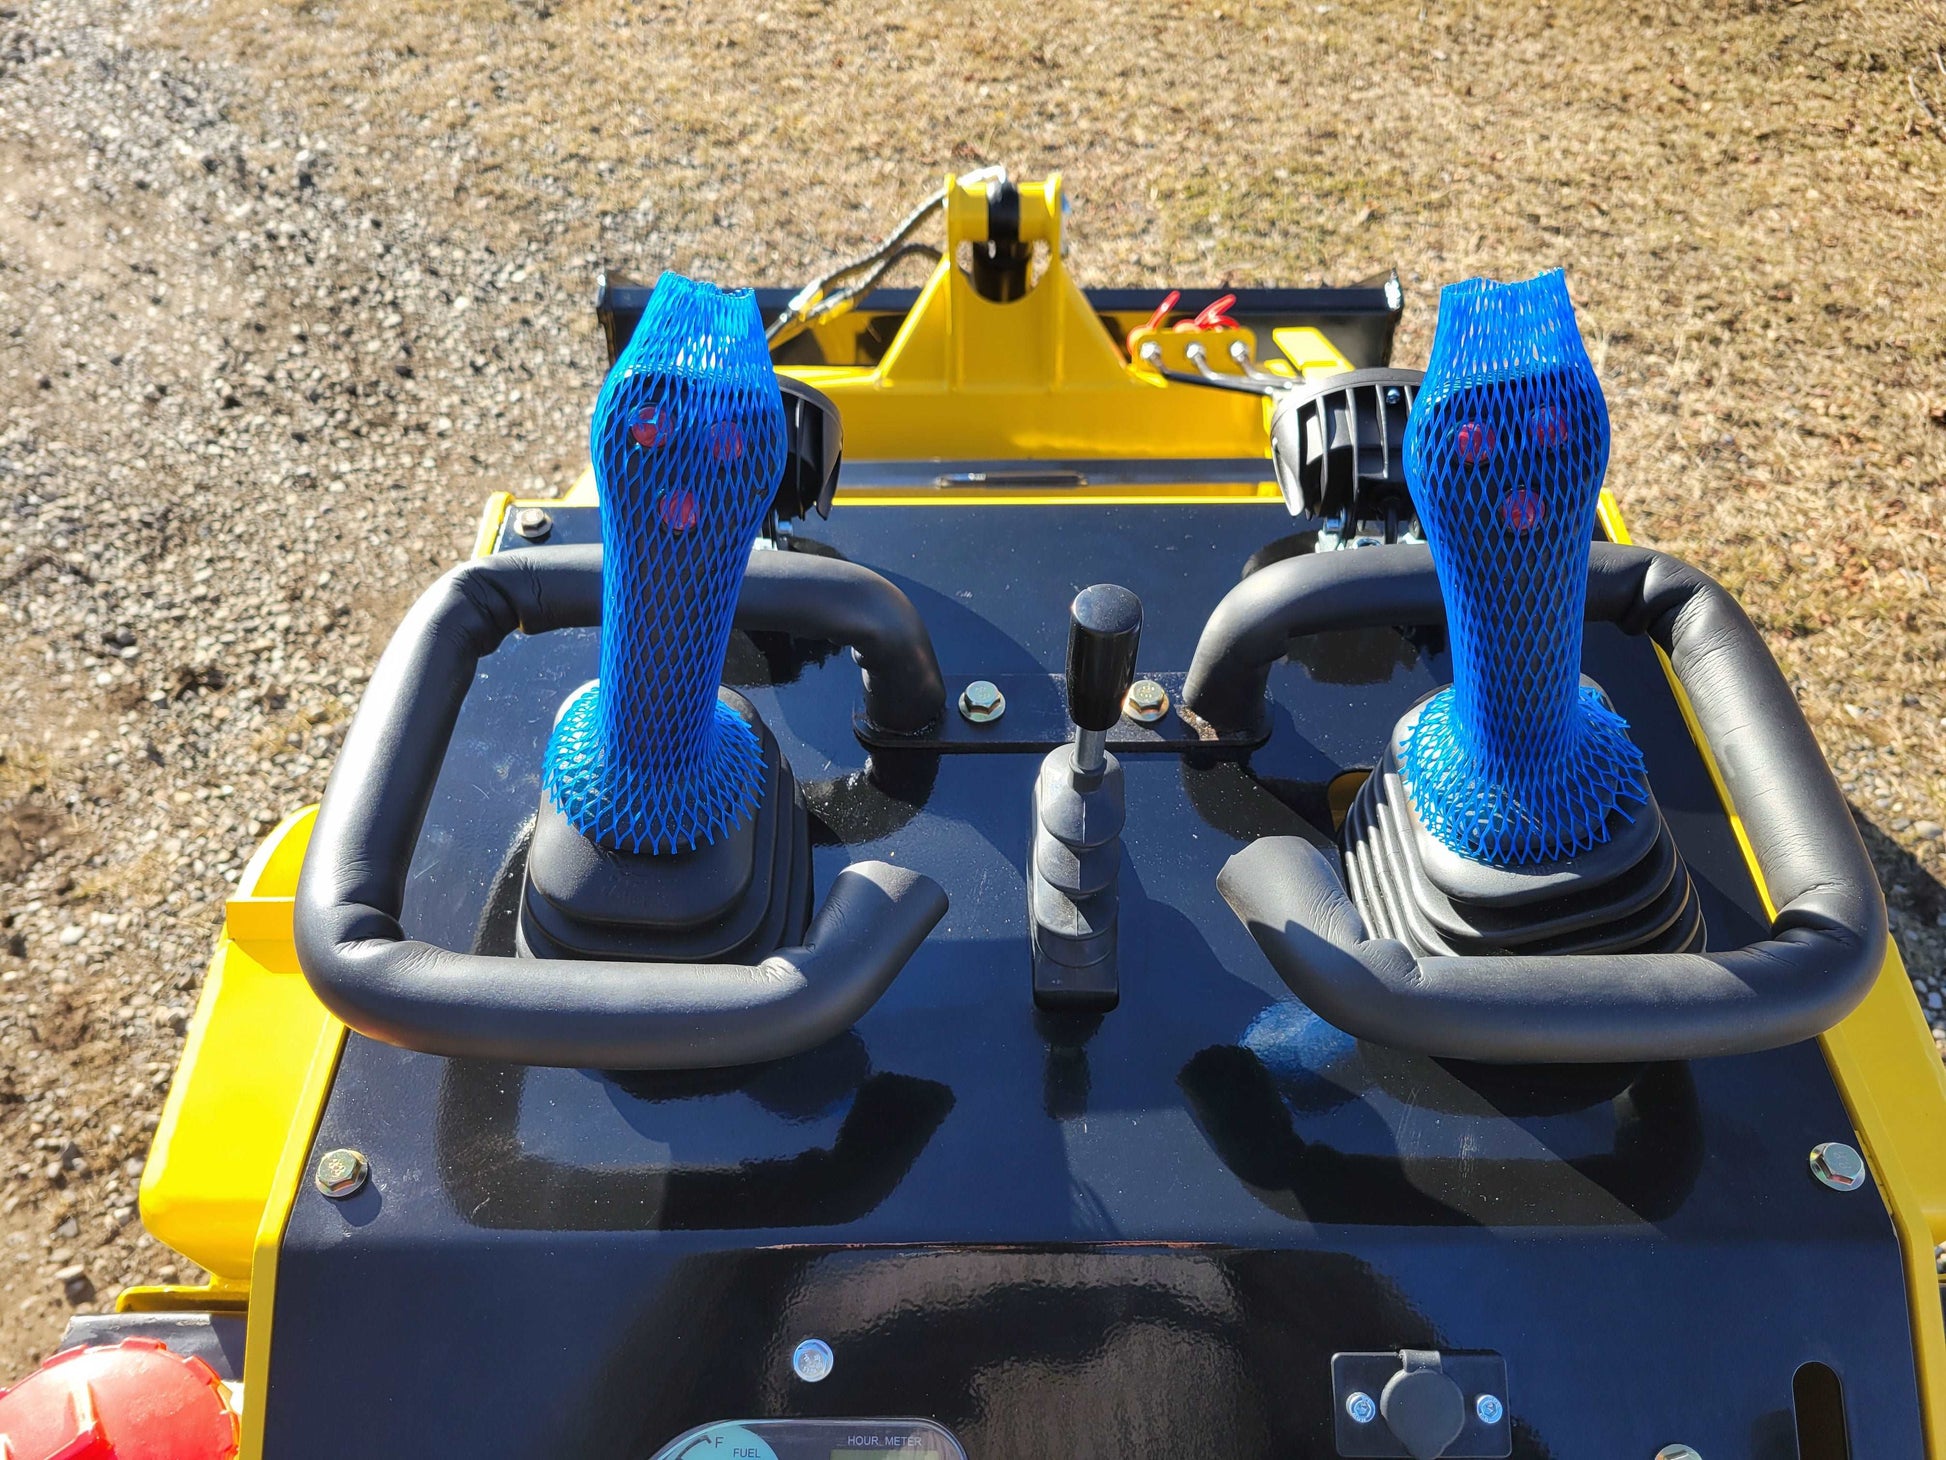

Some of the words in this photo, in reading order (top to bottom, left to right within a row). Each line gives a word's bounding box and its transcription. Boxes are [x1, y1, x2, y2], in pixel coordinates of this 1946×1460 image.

[715, 1437, 724, 1448] F
[847, 1435, 879, 1446] HOUR
[885, 1436, 922, 1447] METER
[733, 1448, 760, 1458] FUEL
